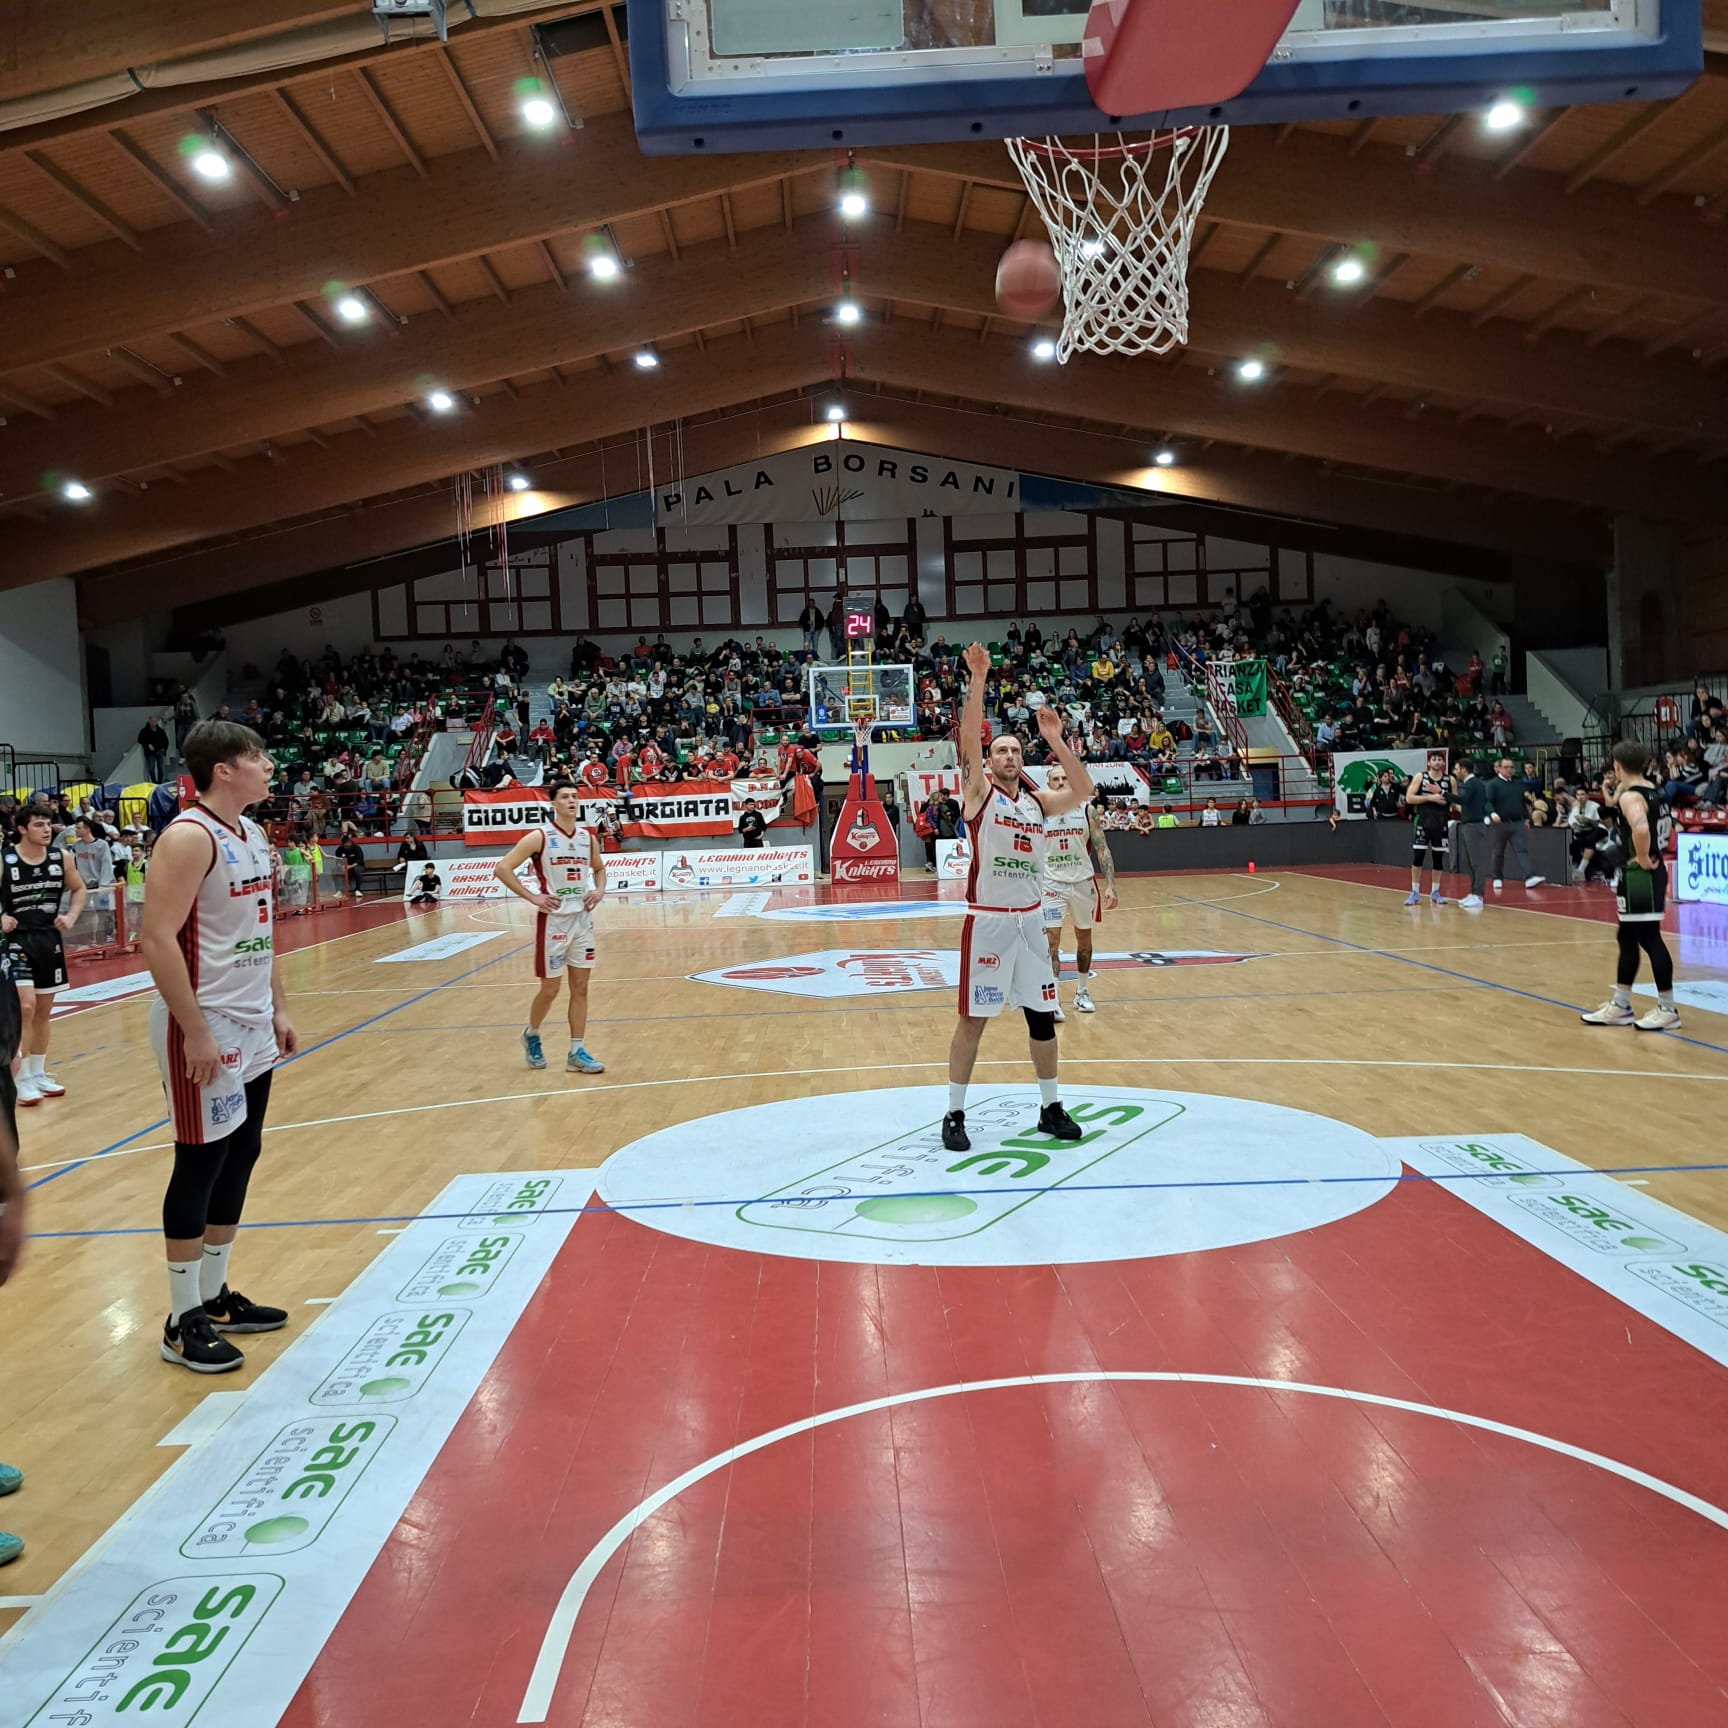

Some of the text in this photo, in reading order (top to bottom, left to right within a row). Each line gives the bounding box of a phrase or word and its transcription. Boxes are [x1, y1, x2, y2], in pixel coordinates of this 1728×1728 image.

[663, 454, 1015, 512] PALA BORSANI
[848, 615, 871, 635] 24
[615, 798, 729, 821] FORGIATA
[1013, 833, 1033, 853] 16
[698, 853, 754, 863] LEGNANO
[452, 874, 497, 883] BASKET
[196, 1428, 315, 1546] scientifica
